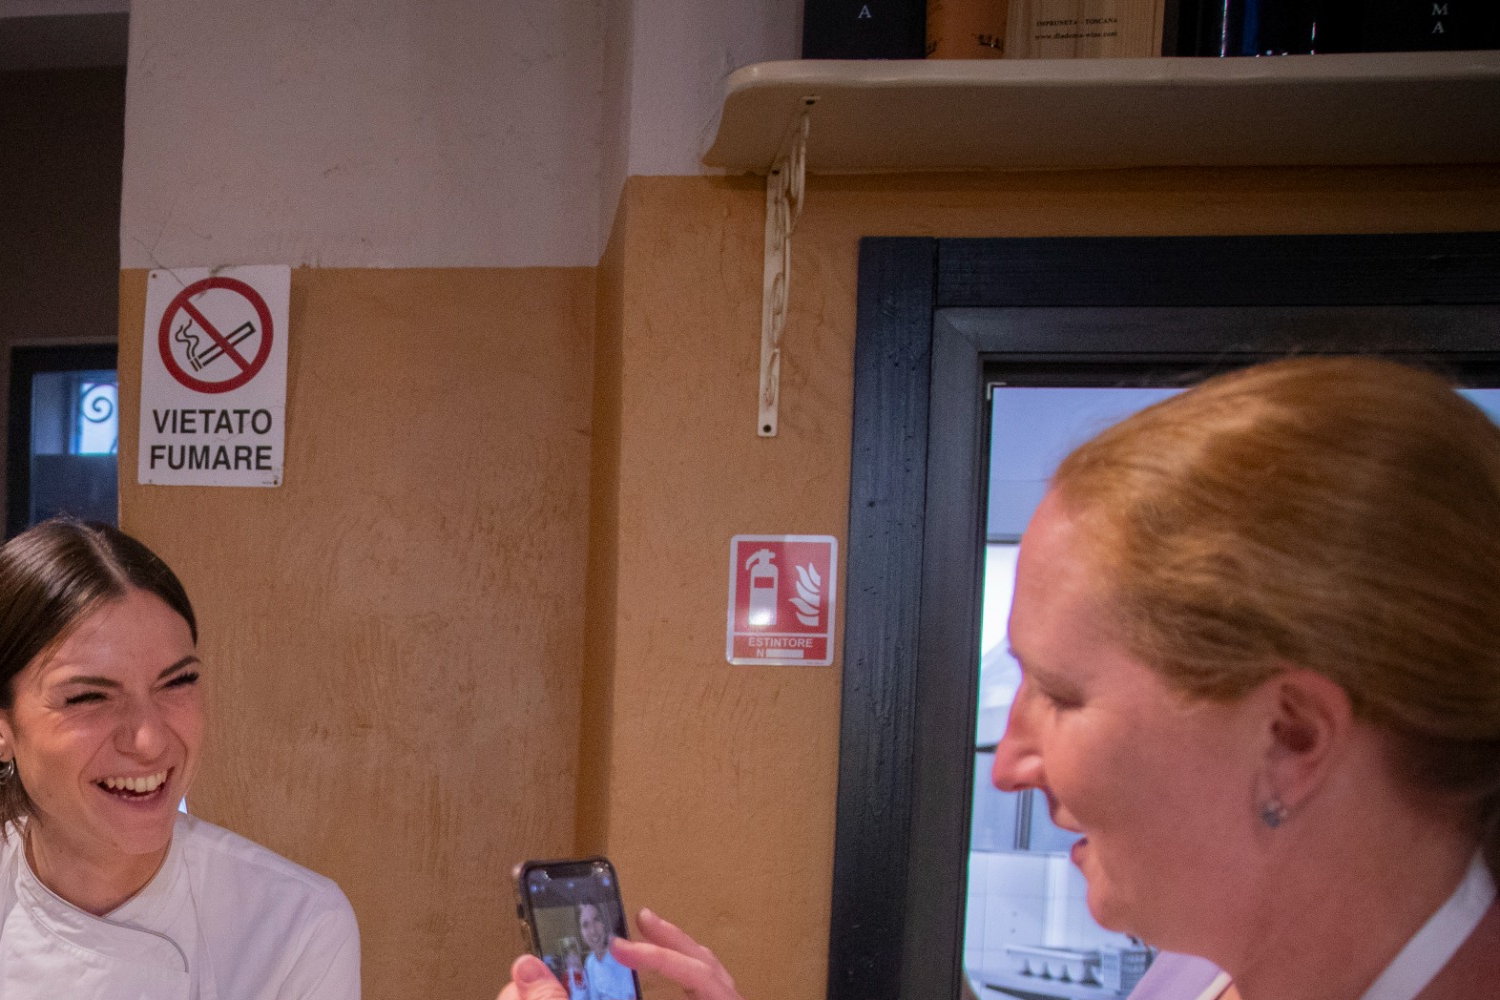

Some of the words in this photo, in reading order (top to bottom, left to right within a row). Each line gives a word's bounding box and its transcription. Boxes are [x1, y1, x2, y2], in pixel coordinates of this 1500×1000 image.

[152, 408, 273, 434] VIETATO
[150, 445, 273, 471] FUMARE
[748, 637, 814, 649] ESTINTORE
